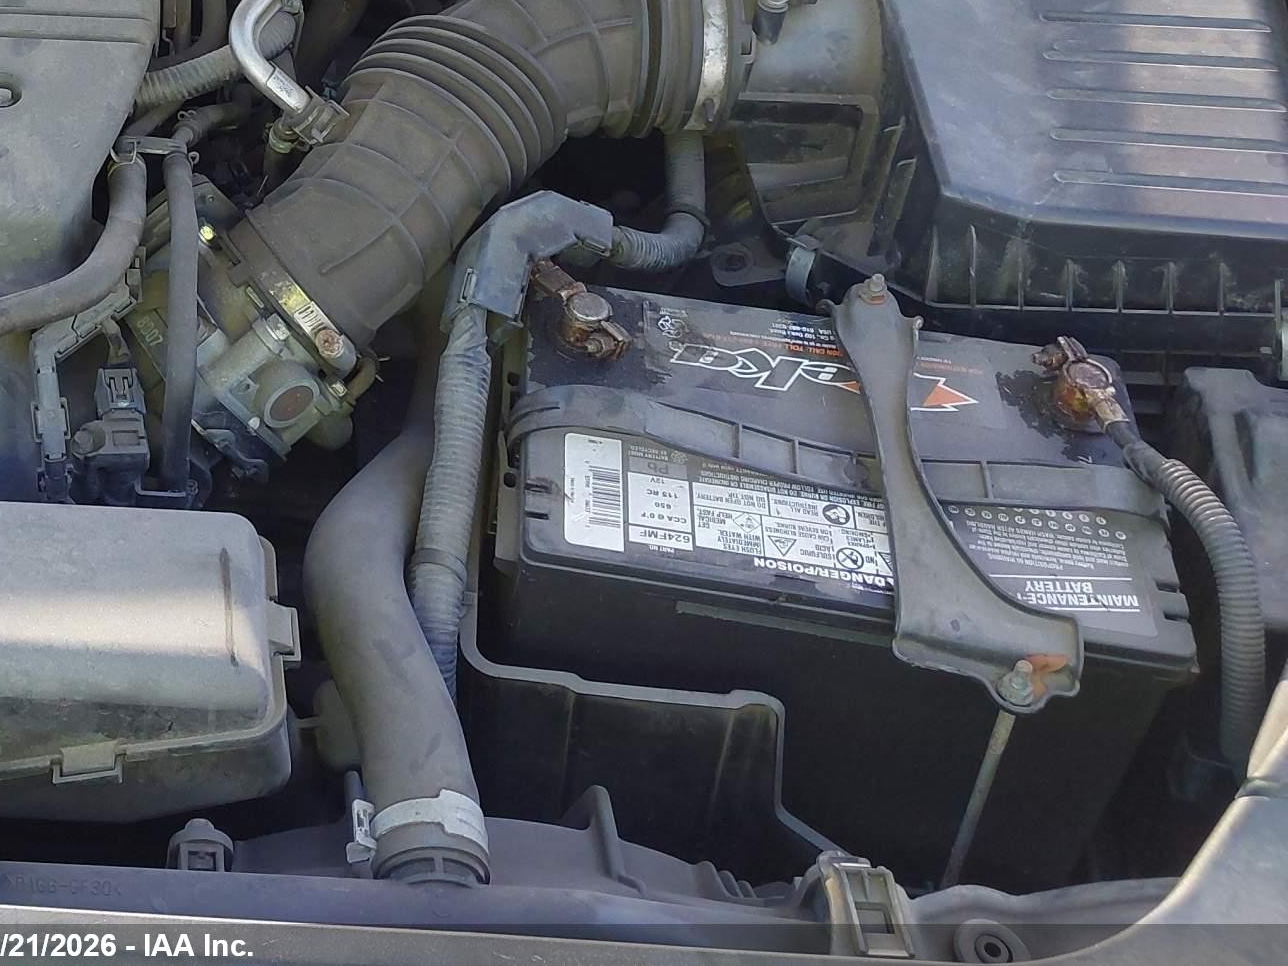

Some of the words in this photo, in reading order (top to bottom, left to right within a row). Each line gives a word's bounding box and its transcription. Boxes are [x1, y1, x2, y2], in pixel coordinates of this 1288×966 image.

[784, 343, 803, 351] TOLL
[669, 346, 862, 392] eka
[646, 461, 669, 474] Pb
[645, 488, 659, 496] RC
[653, 501, 671, 509] 650
[666, 514, 687, 523] CCA
[716, 511, 732, 519] HELP
[638, 528, 690, 543] 624FMF
[741, 545, 762, 554] FLUSH
[814, 544, 830, 552] ACID
[864, 555, 875, 563] NO
[753, 557, 886, 586] DANGER/POISON
[1024, 580, 1093, 594] BATTERY
